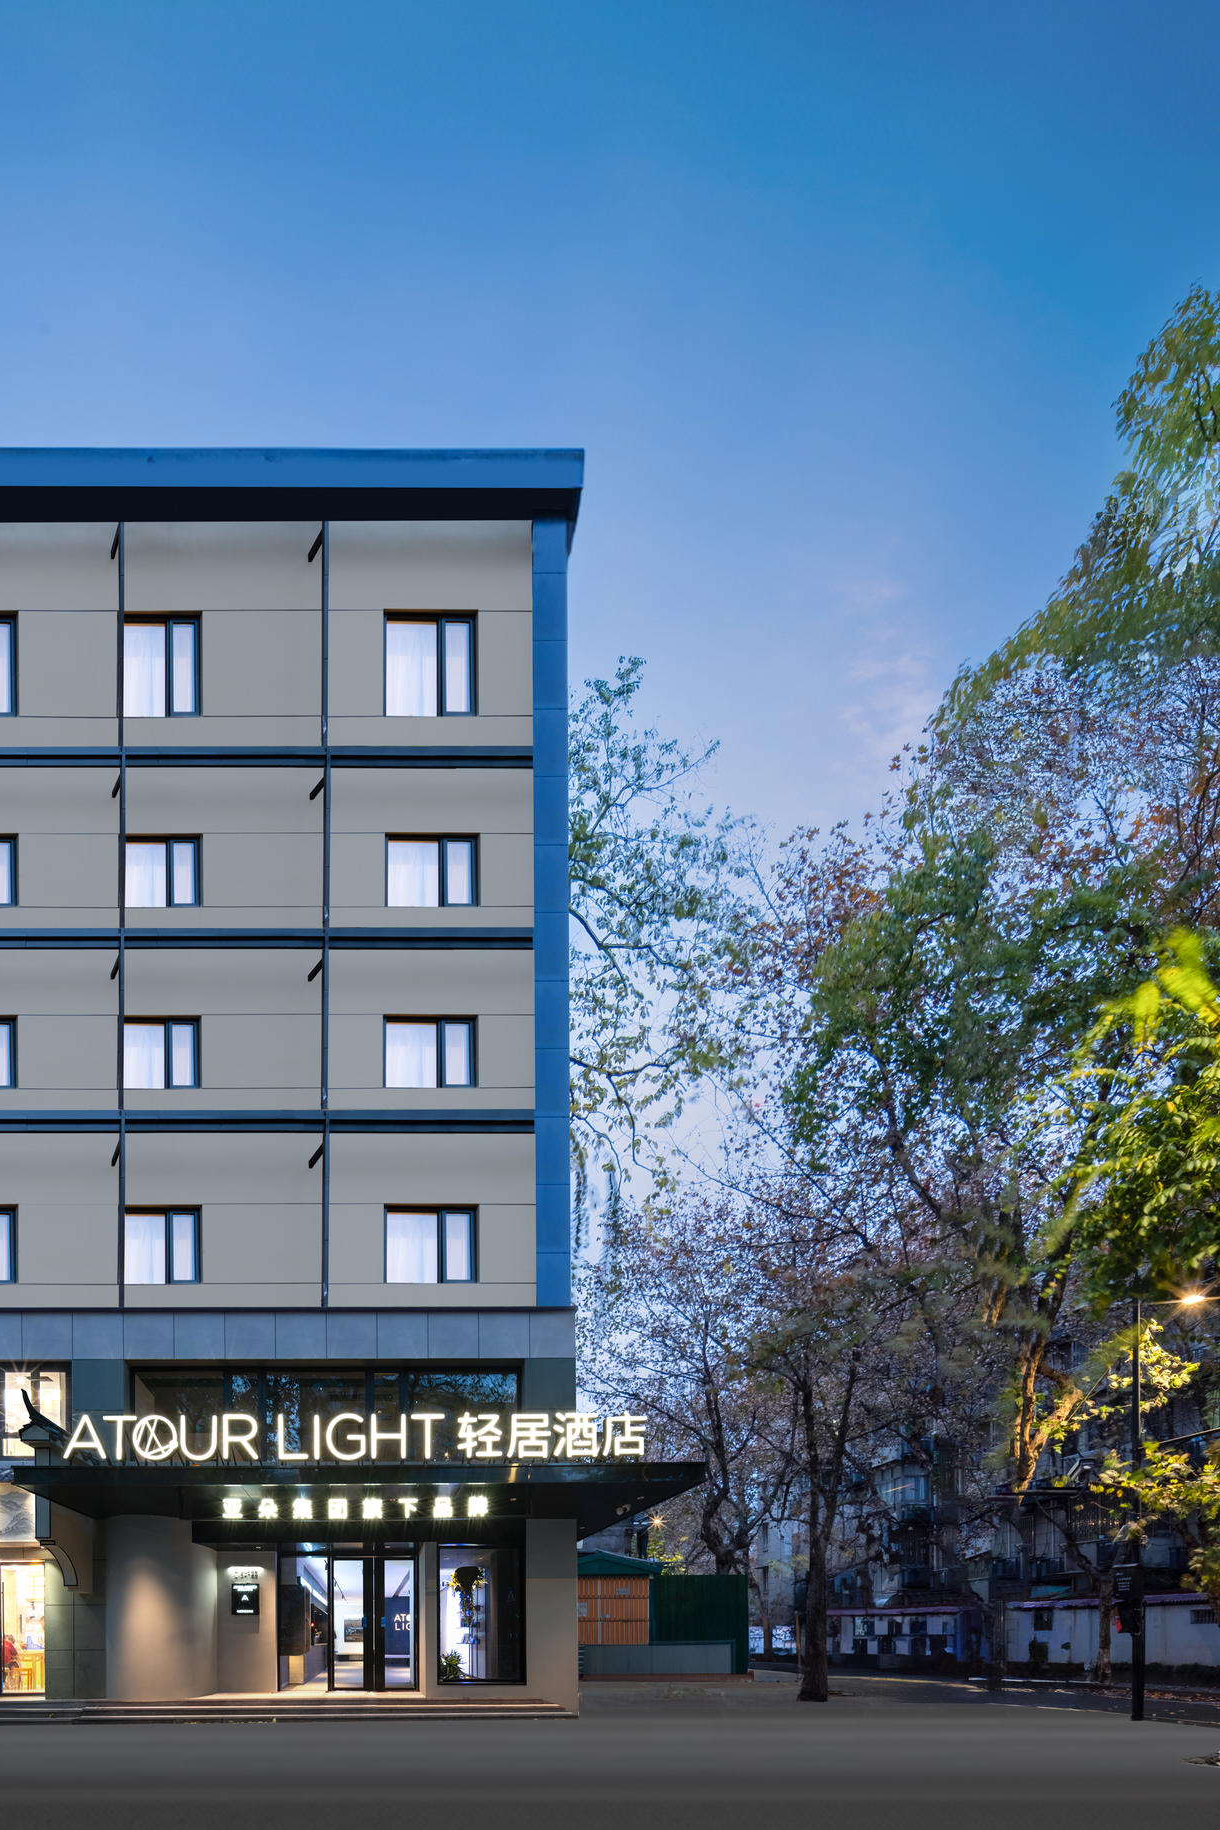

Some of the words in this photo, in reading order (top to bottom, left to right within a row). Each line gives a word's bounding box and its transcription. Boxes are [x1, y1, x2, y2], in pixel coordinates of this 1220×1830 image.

[62, 1414, 259, 1461] ATOUR
[277, 1413, 445, 1461] LIGHT
[456, 1411, 648, 1459] 轻居酒店
